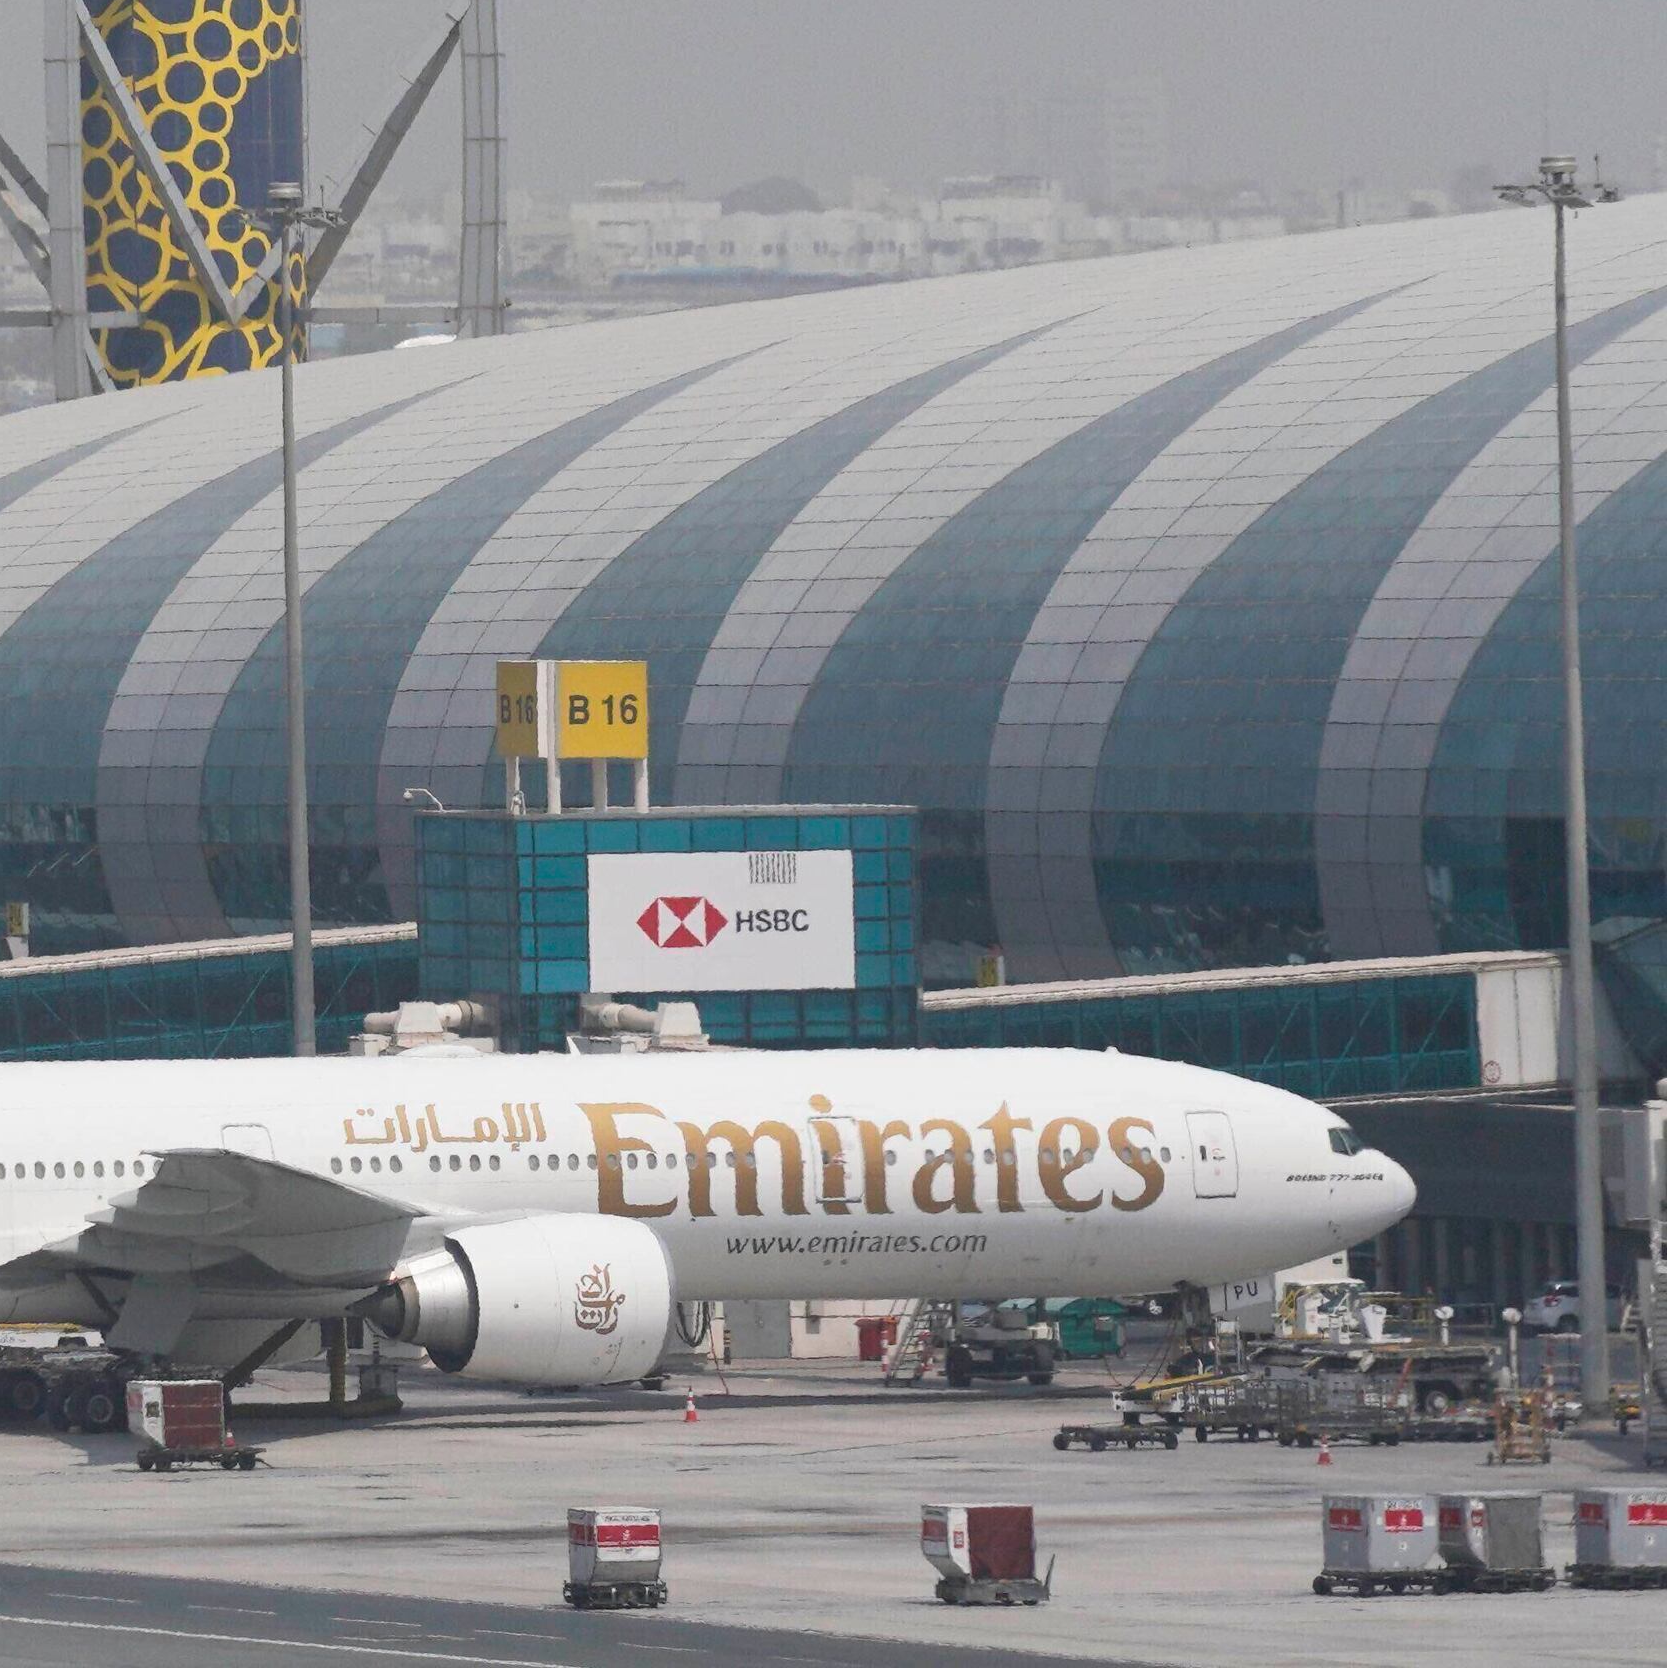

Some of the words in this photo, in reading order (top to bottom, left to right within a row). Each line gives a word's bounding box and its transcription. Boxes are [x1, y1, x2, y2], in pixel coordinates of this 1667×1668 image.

[569, 694, 589, 725] B
[602, 693, 638, 725] 16
[736, 909, 809, 932] HSBC
[343, 1102, 547, 1152] الإمارات
[576, 1094, 1165, 1217] Emirates
[726, 1230, 988, 1254] www.emirates.com
[1234, 1281, 1258, 1300] PU
